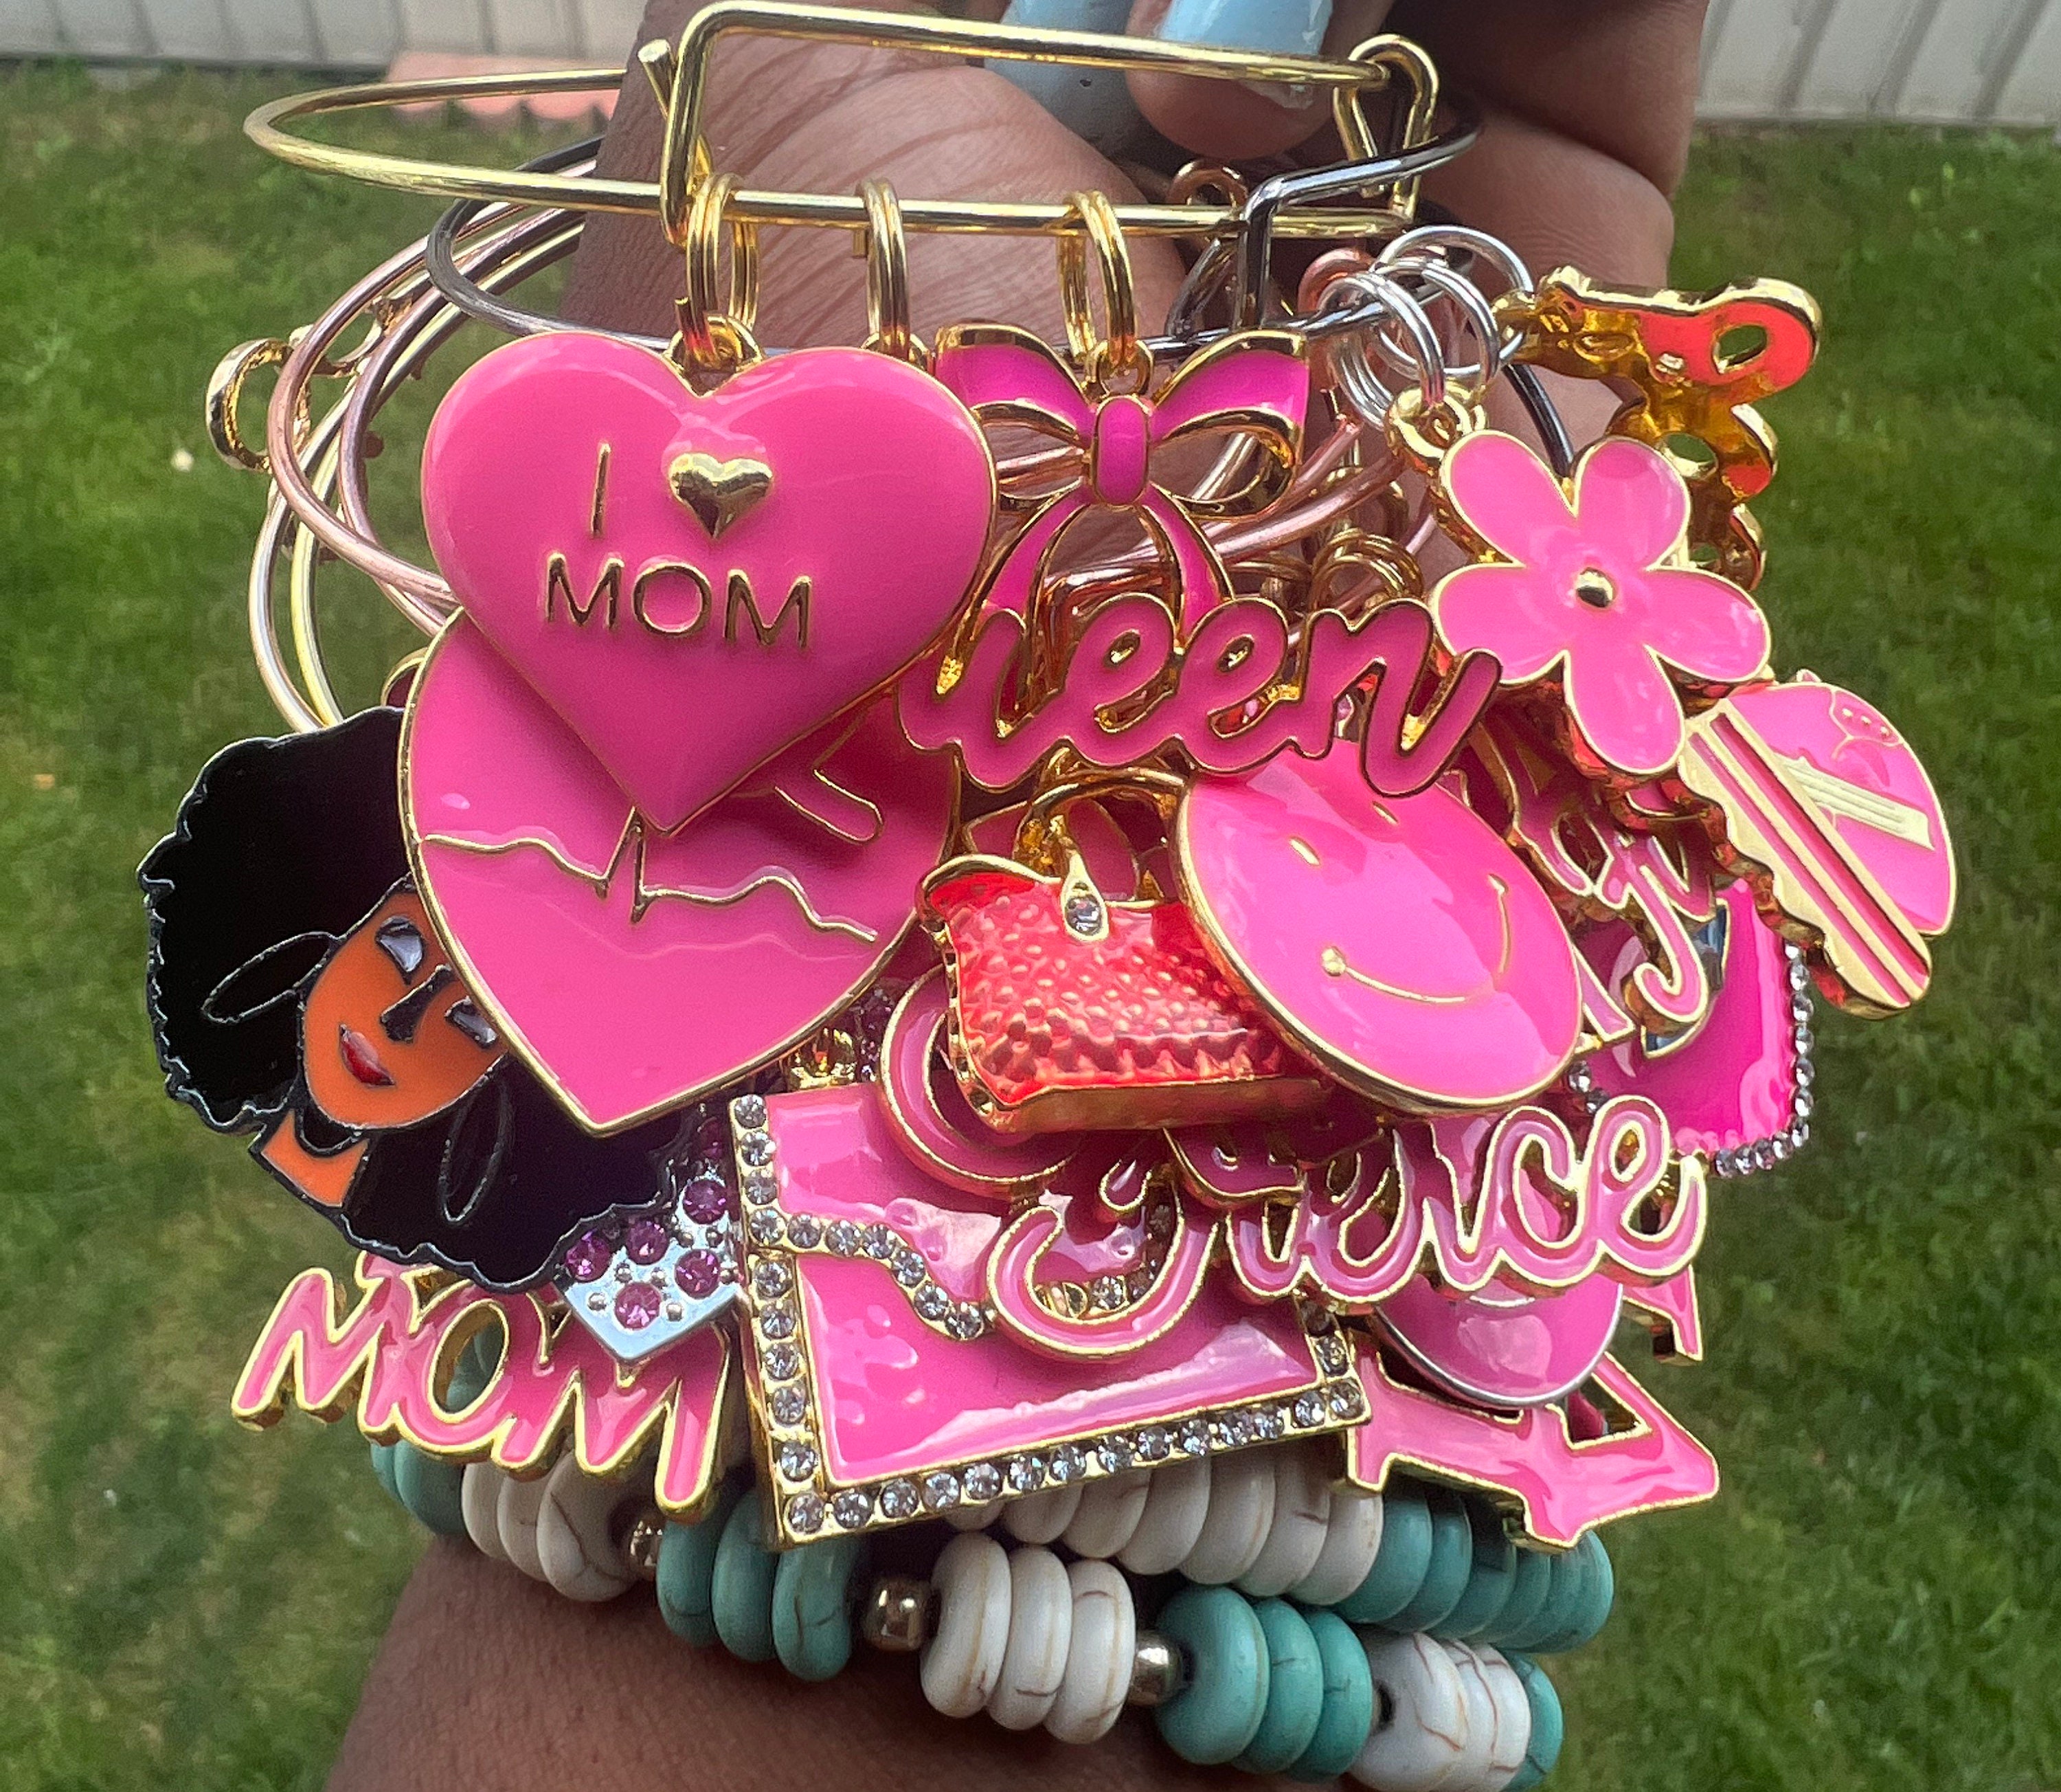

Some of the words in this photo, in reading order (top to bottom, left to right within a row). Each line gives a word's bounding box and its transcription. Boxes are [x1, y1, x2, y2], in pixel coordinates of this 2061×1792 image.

[589, 443, 611, 537] I
[545, 552, 813, 650] MOM
[897, 592, 1503, 798] ueen
[231, 1252, 730, 1513] MOM
